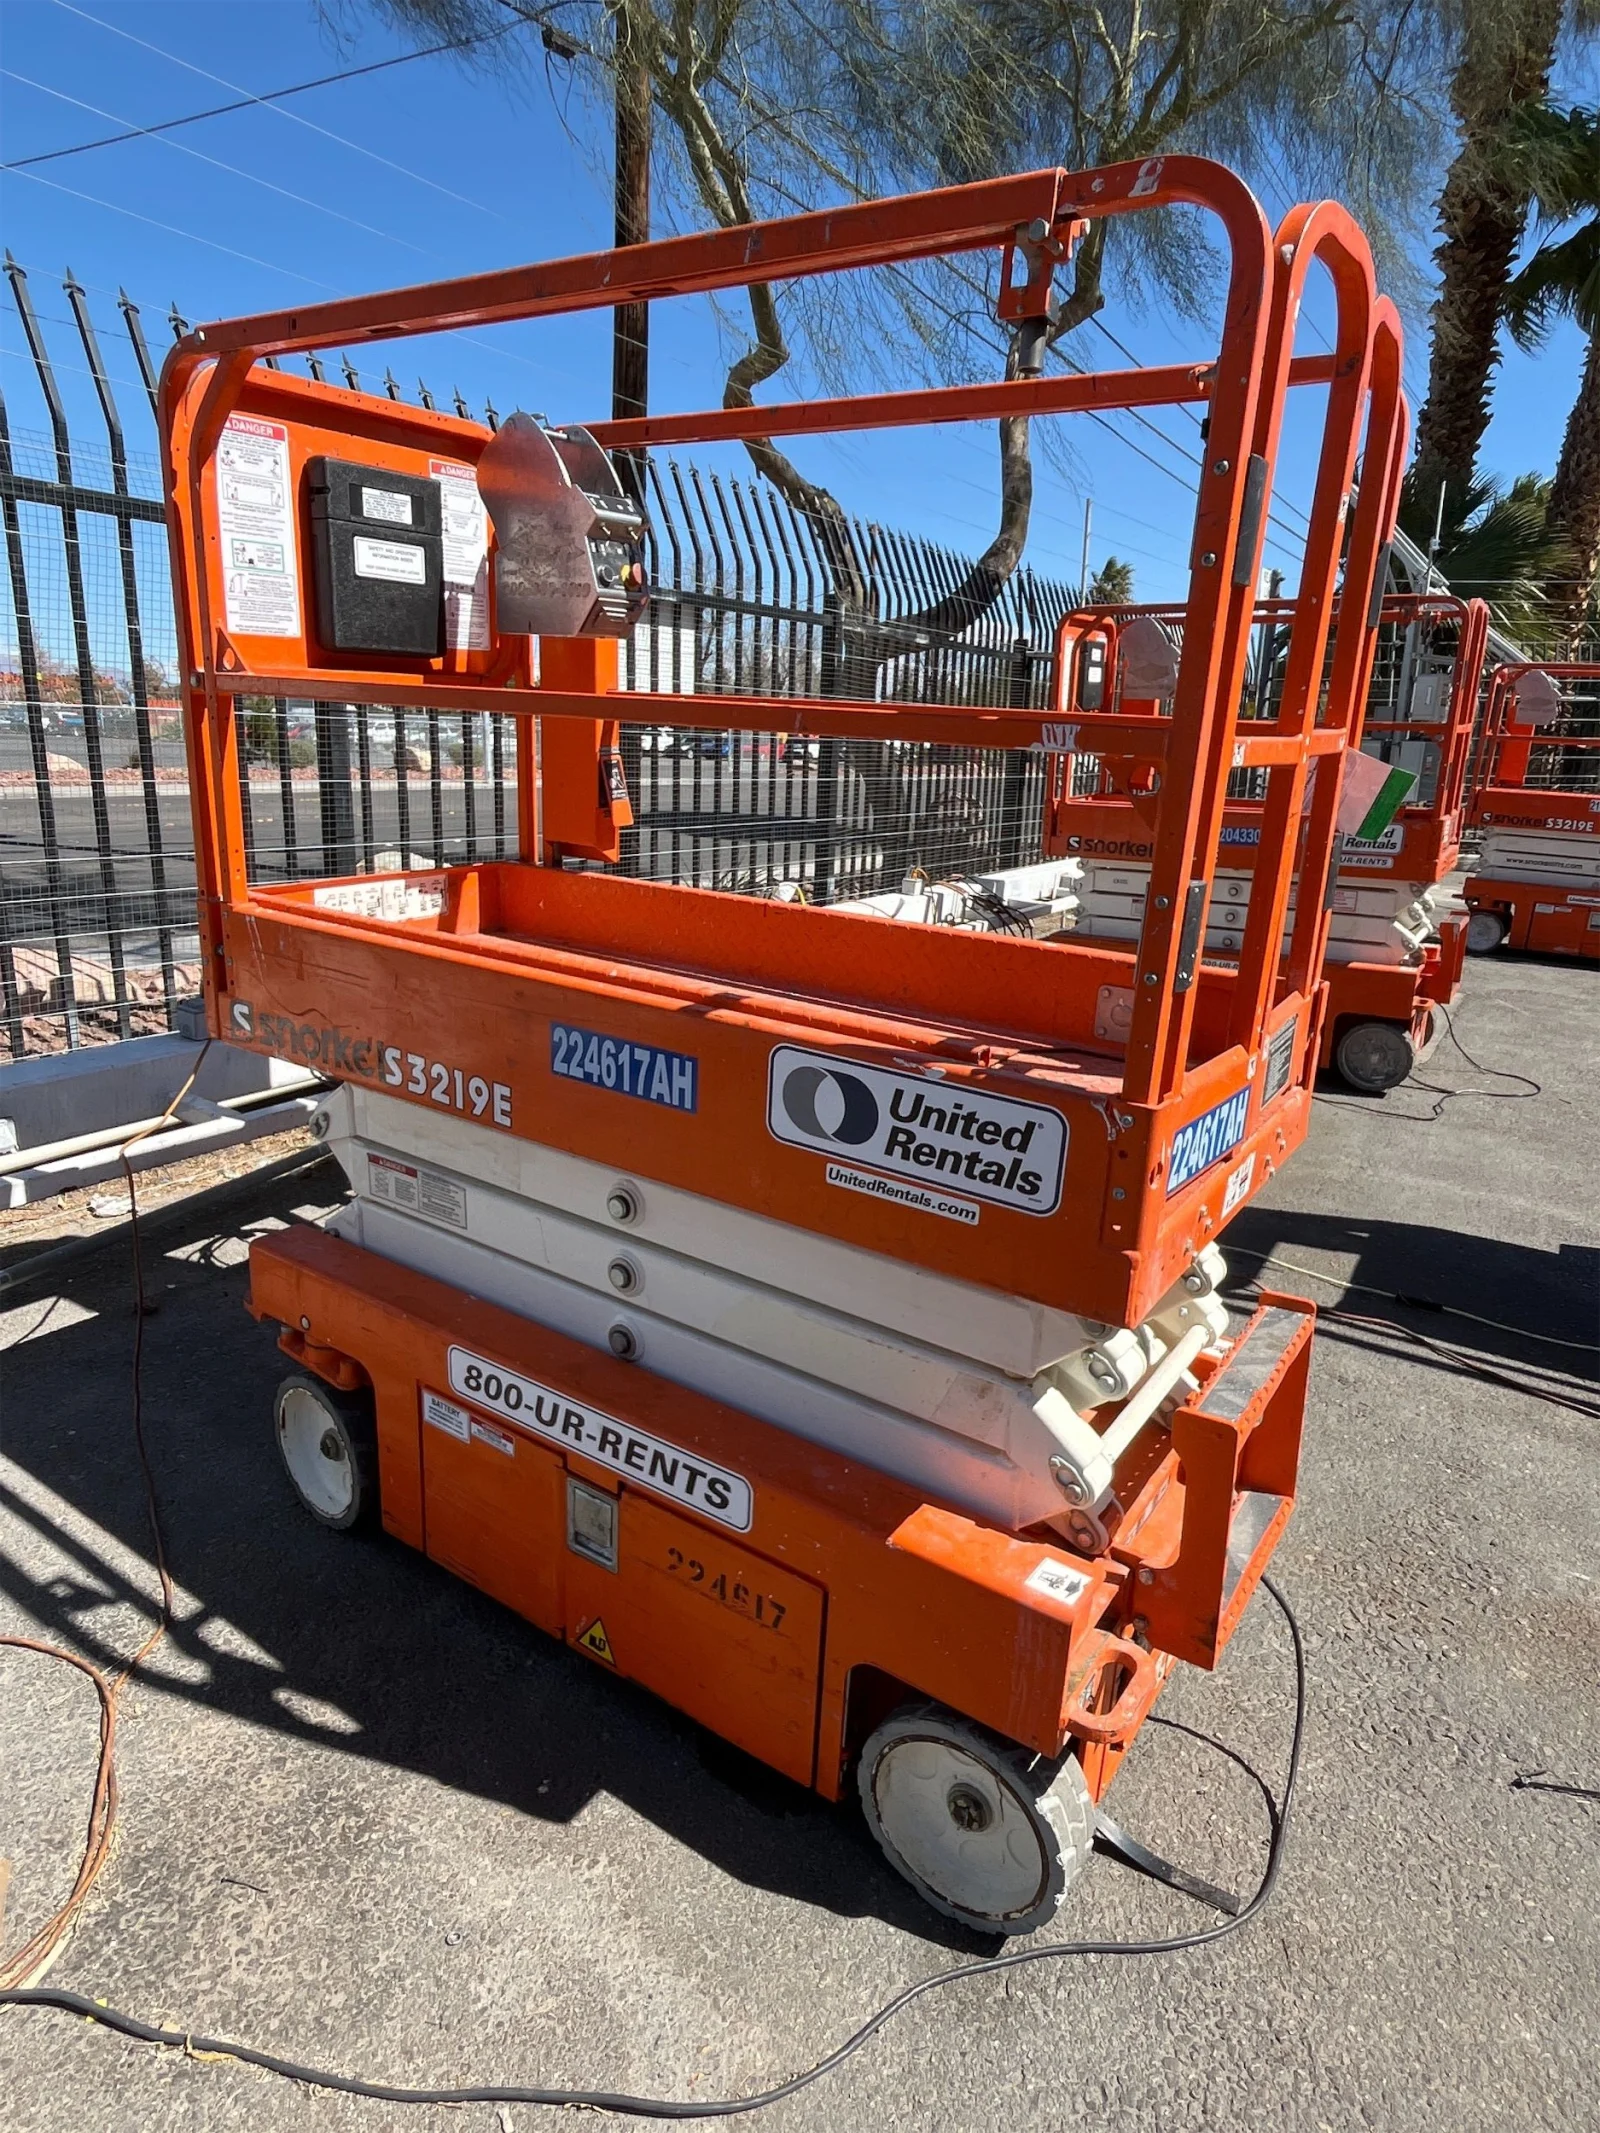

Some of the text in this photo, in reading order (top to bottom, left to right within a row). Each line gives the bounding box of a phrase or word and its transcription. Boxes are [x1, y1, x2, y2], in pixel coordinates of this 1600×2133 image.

[231, 418, 274, 438] DANGER
[1084, 838, 1154, 858] snorkel
[1345, 837, 1398, 850] Rentals
[1545, 818, 1595, 832] S3219E
[1340, 855, 1388, 866] UR-RENTS
[259, 1011, 386, 1083] snorkel
[384, 1045, 513, 1128] S3219E
[552, 1026, 693, 1110] 224617AH
[883, 1124, 1043, 1197] Rentals
[1167, 1088, 1250, 1193] 224617AH
[828, 1166, 977, 1222] UnitedRentals.com
[431, 1397, 460, 1418] BATTERY
[464, 1363, 732, 1510] 800-UR-RENTS
[668, 1547, 787, 1629] 224617
